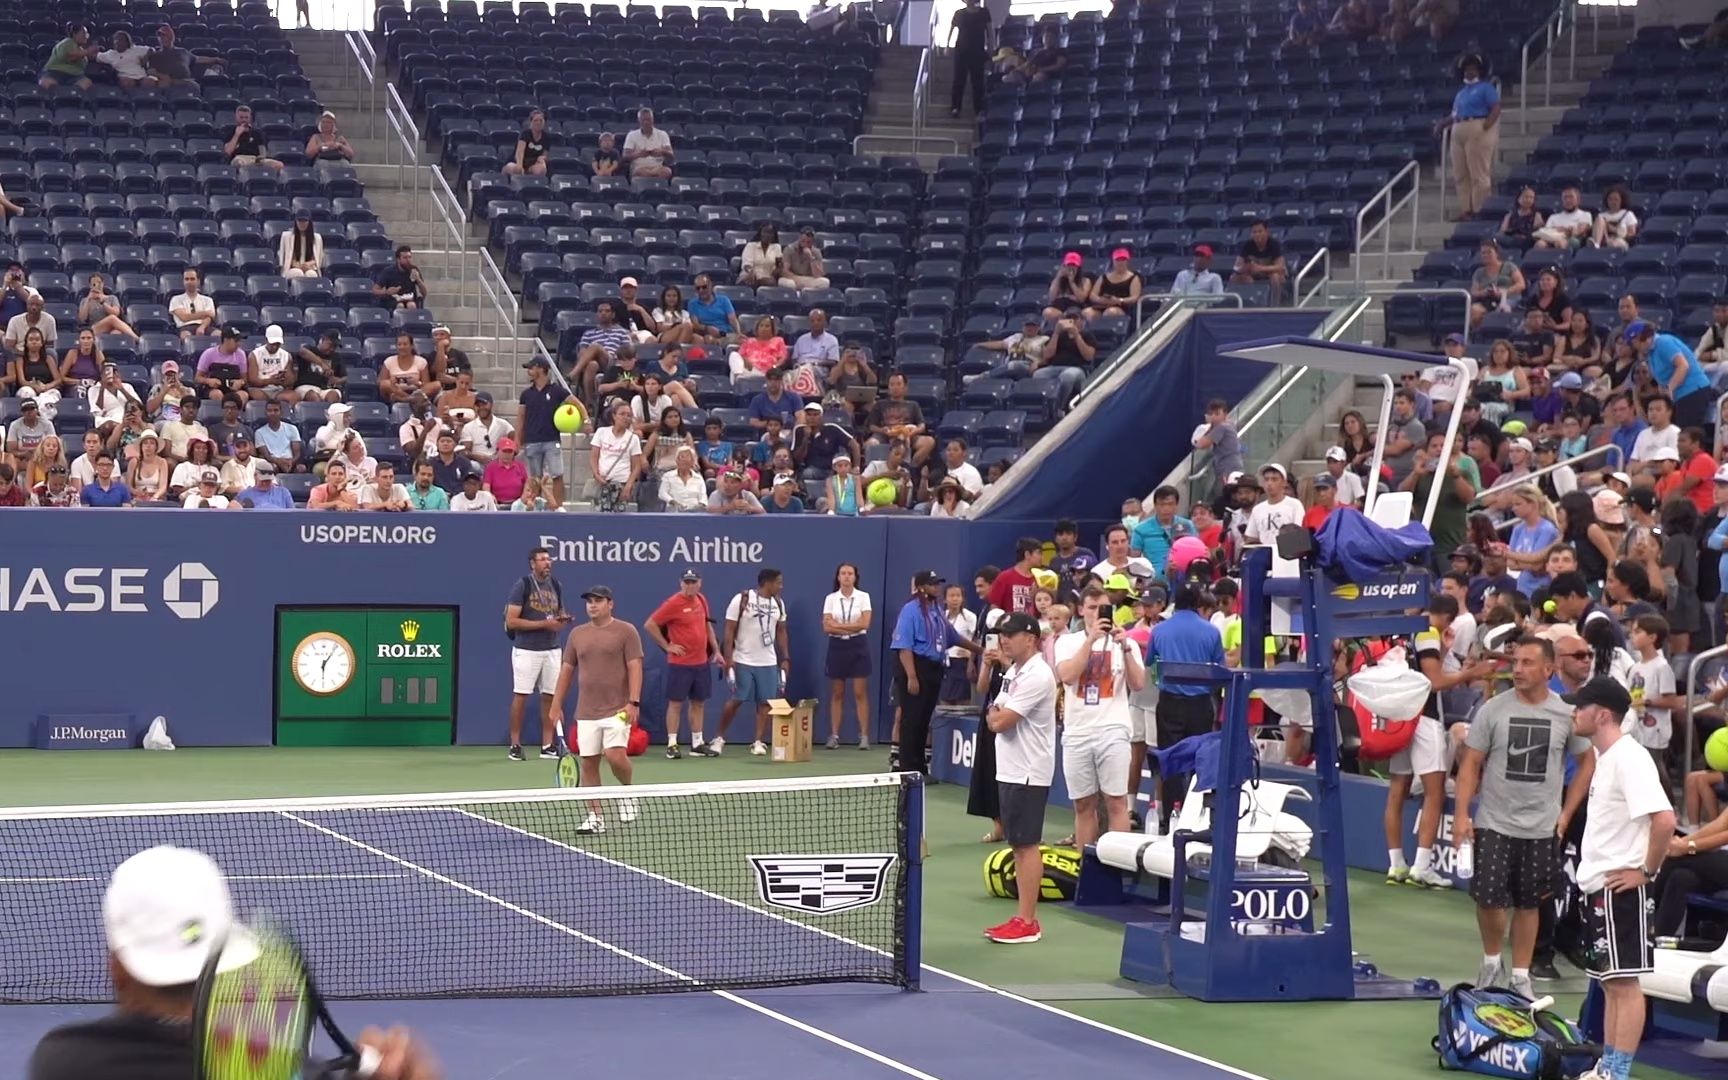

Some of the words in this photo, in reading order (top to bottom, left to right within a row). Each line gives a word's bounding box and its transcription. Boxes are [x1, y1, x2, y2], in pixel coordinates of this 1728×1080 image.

[300, 524, 437, 545] USOPEN.ORG
[539, 534, 661, 562] Emirates
[669, 536, 763, 563] Airline
[1362, 583, 1380, 597] us
[1380, 582, 1417, 599] open
[377, 644, 442, 658] ROLEX
[50, 725, 127, 743] J.P.Morgan
